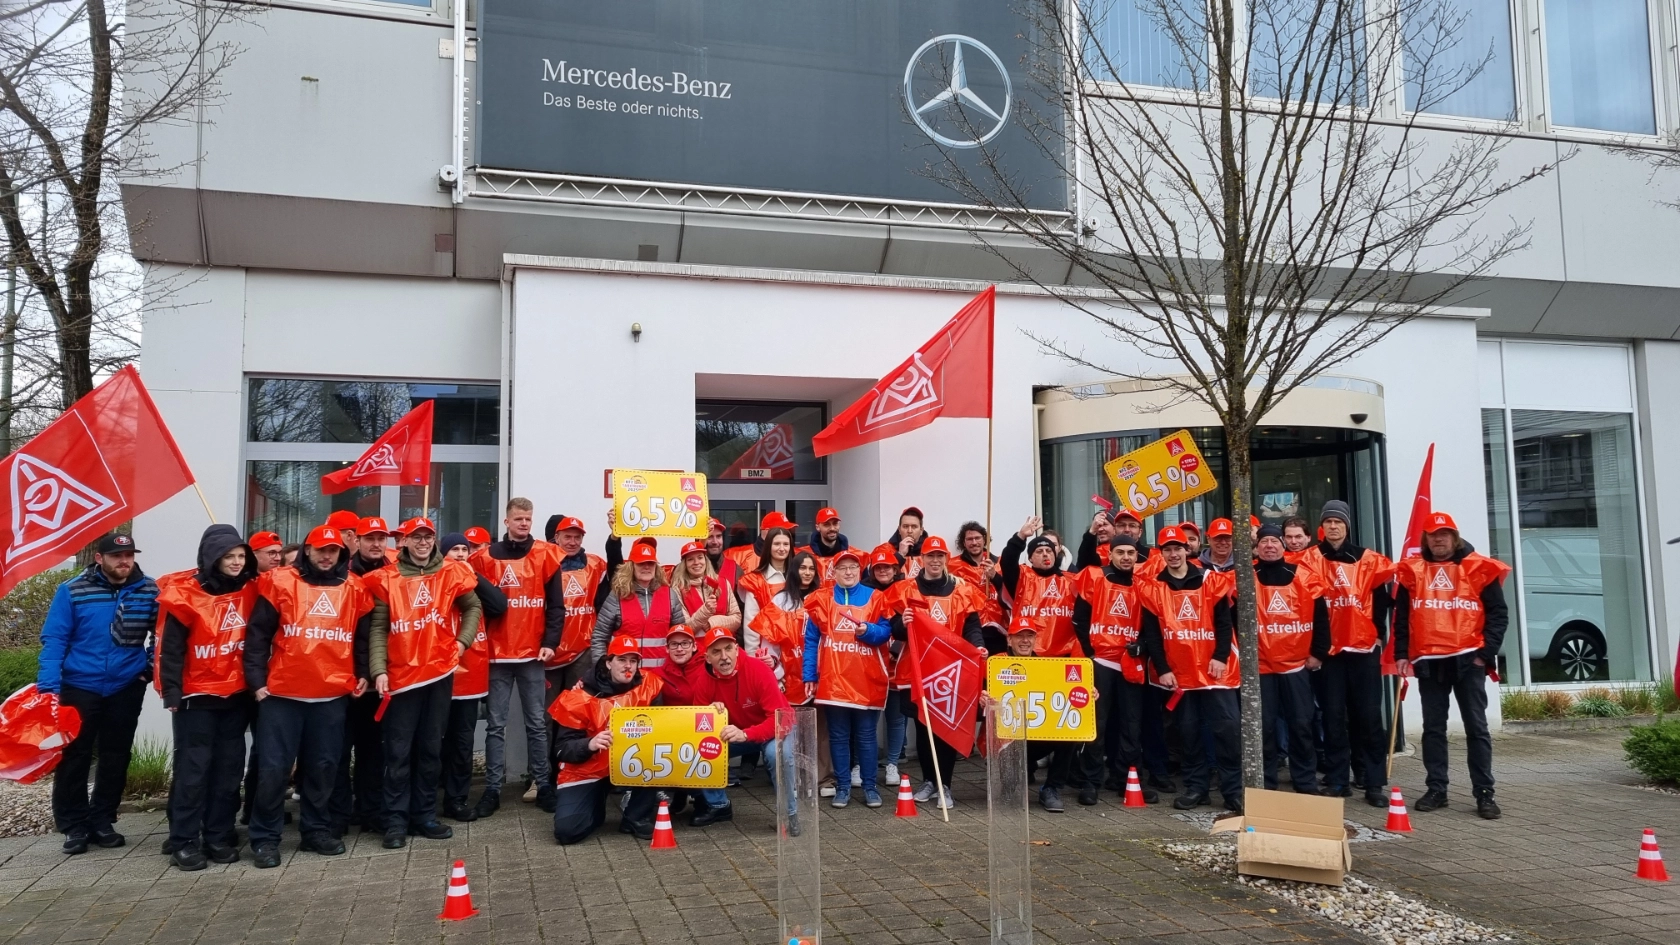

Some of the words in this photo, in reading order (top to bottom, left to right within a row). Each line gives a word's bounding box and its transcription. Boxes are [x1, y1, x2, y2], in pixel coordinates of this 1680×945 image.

[541, 58, 732, 99] Mercedes-Benz
[543, 91, 571, 107] Das
[576, 95, 617, 112] Beste
[621, 100, 654, 115] oder
[657, 103, 703, 119] nichts.
[747, 469, 764, 477] BMZ
[622, 495, 666, 532] 6,5
[507, 596, 543, 608] reiken
[1425, 596, 1479, 611] streiken
[194, 643, 217, 659] Wir
[620, 742, 674, 782] 6,5
